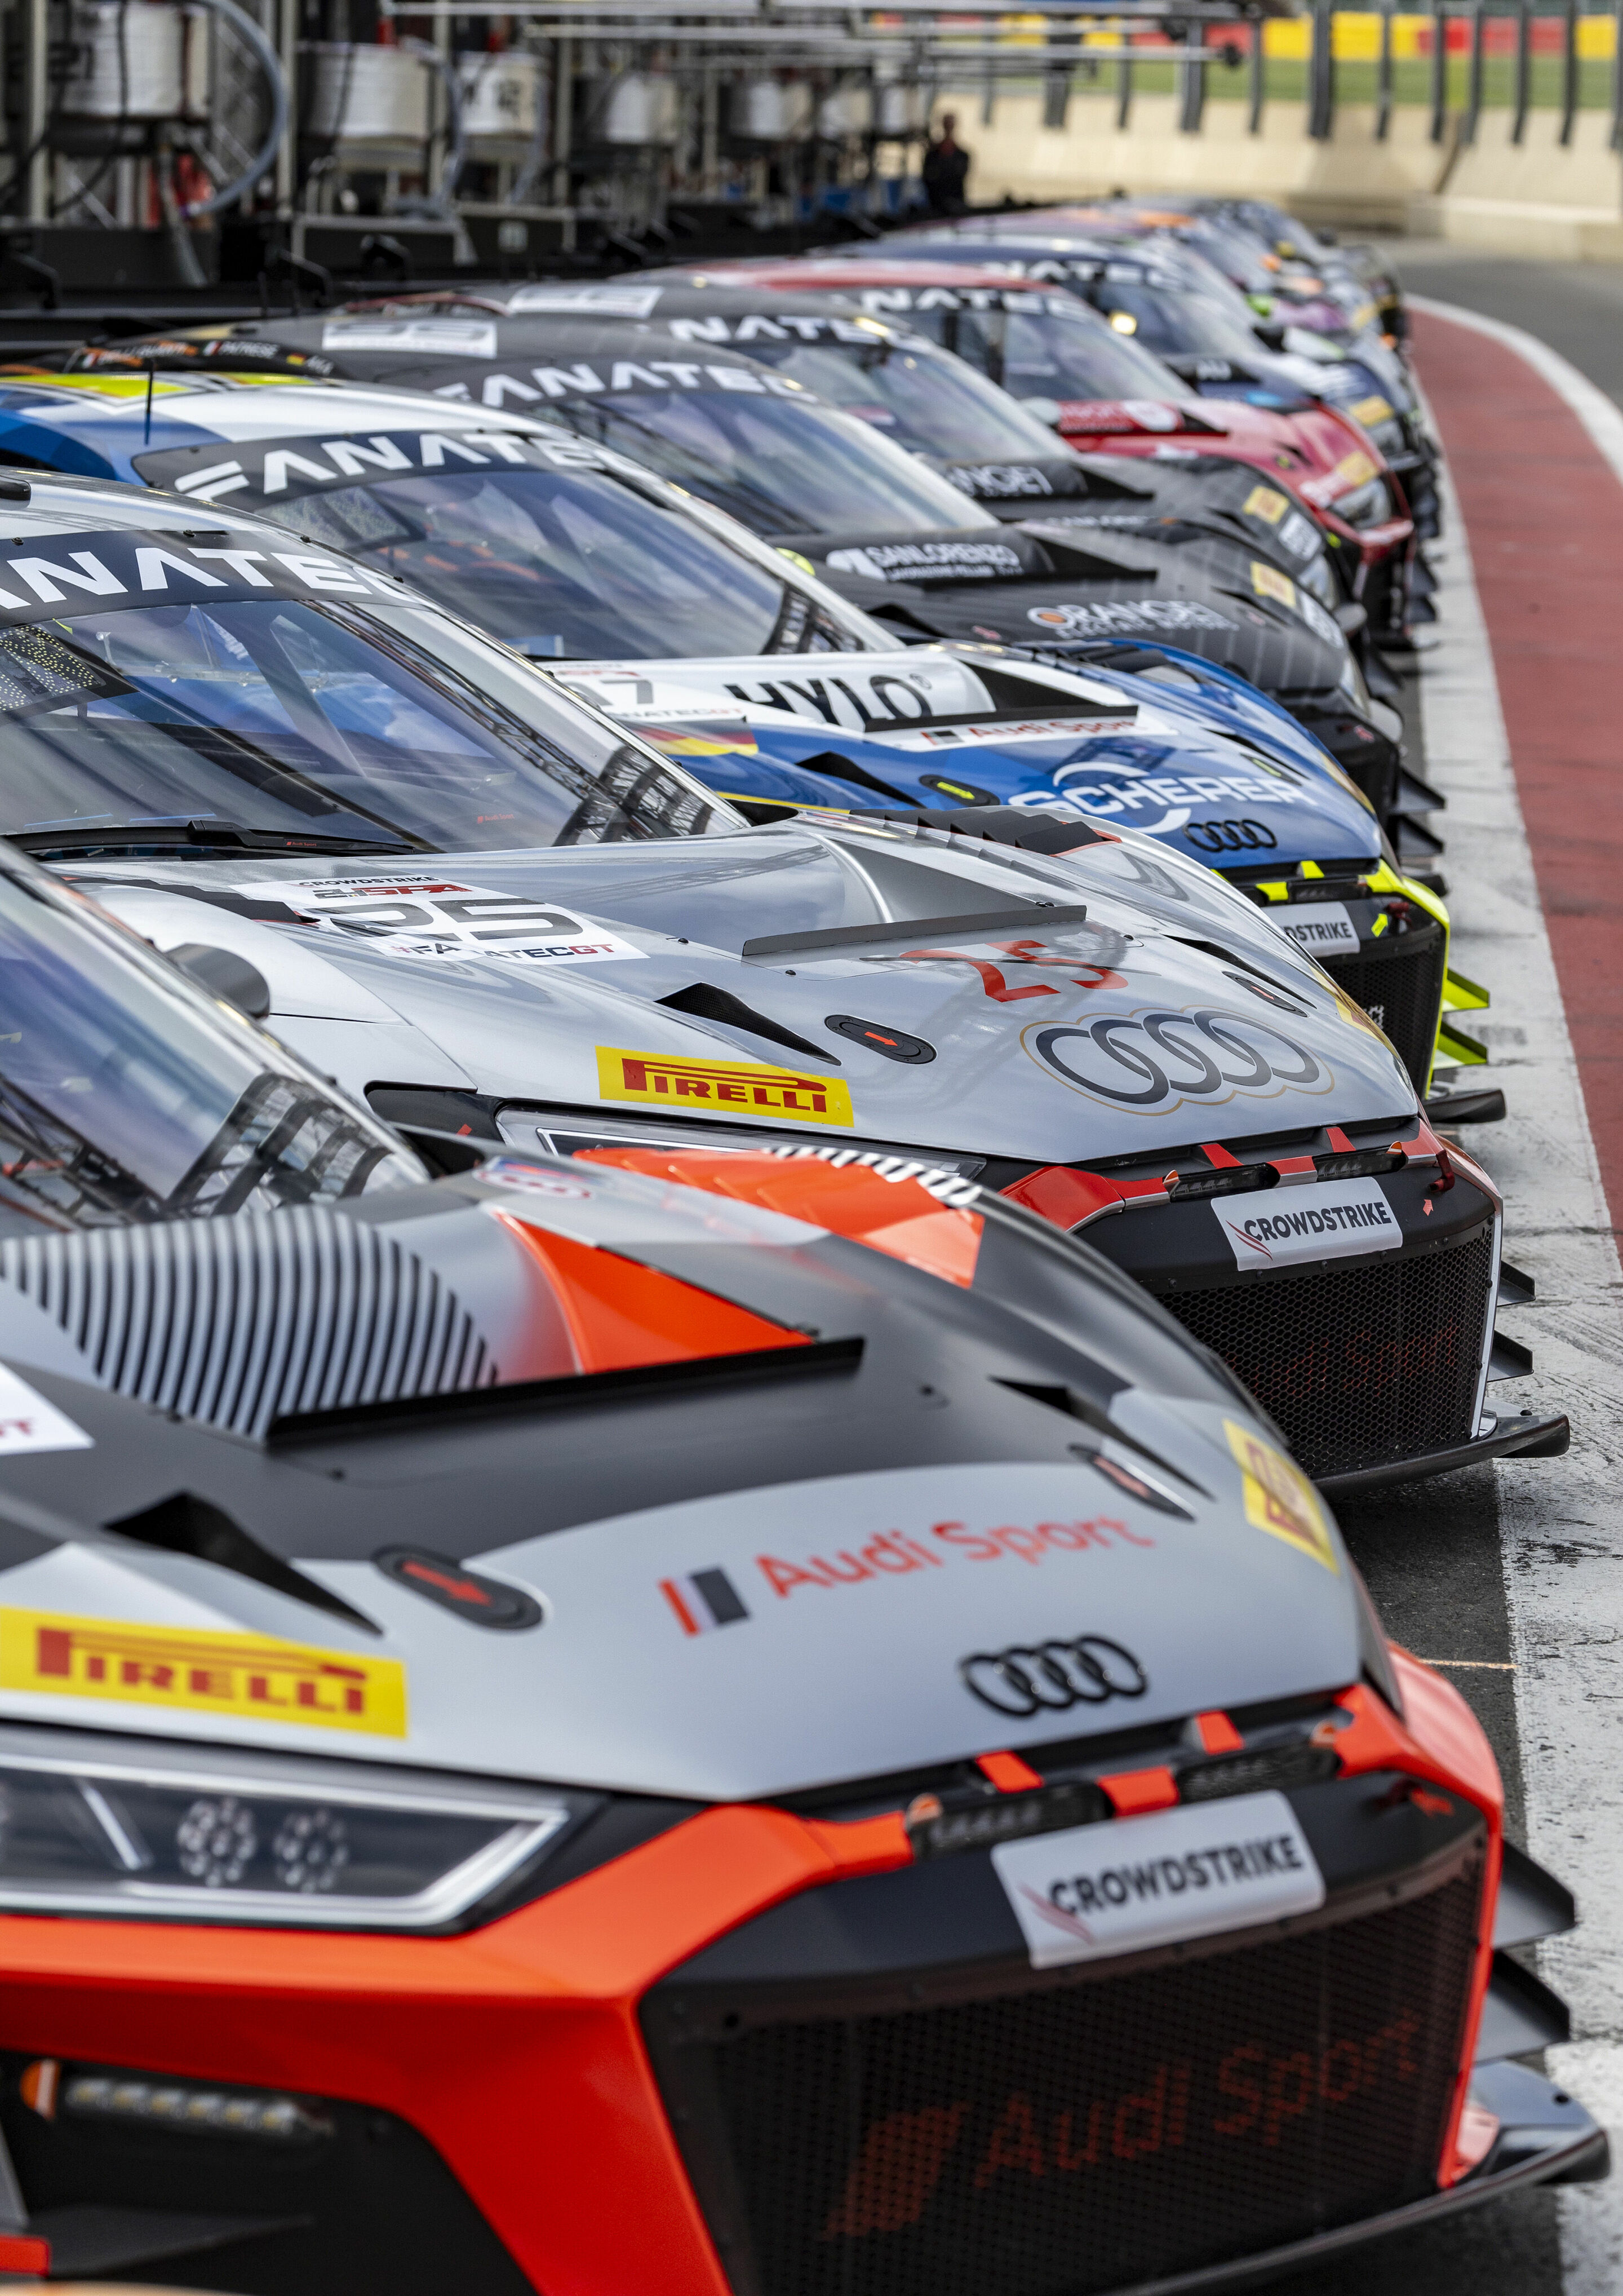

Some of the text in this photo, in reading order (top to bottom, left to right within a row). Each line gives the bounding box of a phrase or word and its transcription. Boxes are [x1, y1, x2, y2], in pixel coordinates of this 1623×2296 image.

[968, 720, 1144, 740] Audi Sport
[1008, 776, 1318, 815] SCHERER
[298, 876, 439, 887] CROWDSTRIKE
[303, 897, 584, 943] 25
[390, 943, 616, 959] #FAATECGT
[898, 939, 1129, 1003] 25
[621, 1058, 827, 1113] PIRELLI
[1243, 1201, 1392, 1242] CROWDSTRIKE
[754, 1512, 1156, 1600] Audi Sport
[35, 1626, 370, 1716] PIRELLI
[1048, 1833, 1303, 1915] CROWDSTRIKE
[973, 2006, 1422, 2190] Audi Sport
